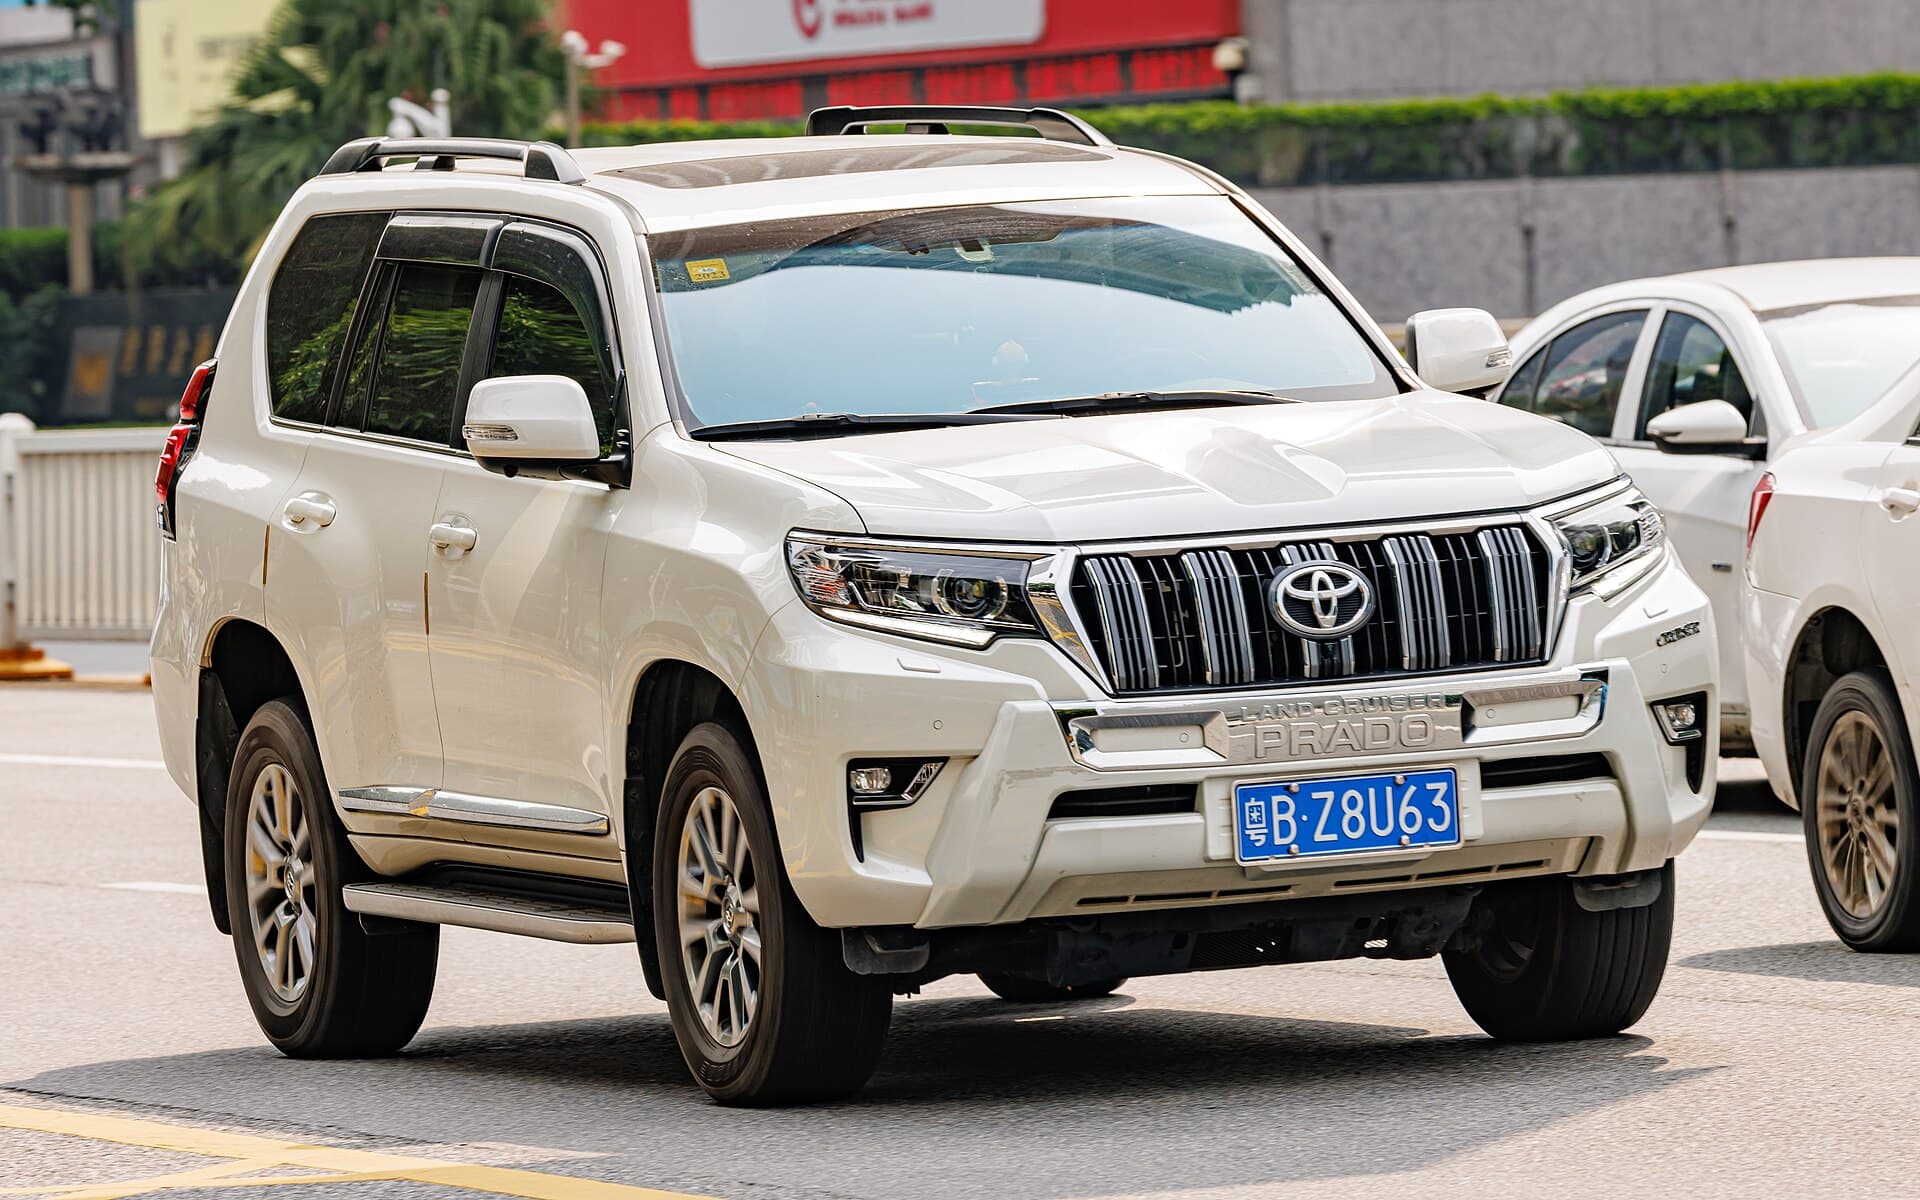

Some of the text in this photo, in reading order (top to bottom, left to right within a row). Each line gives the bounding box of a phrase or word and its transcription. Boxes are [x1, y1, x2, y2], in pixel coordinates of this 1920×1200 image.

[695, 271, 726, 280] 2023
[1240, 692, 1446, 722] LAND CRUISER
[1254, 714, 1435, 758] PRADO
